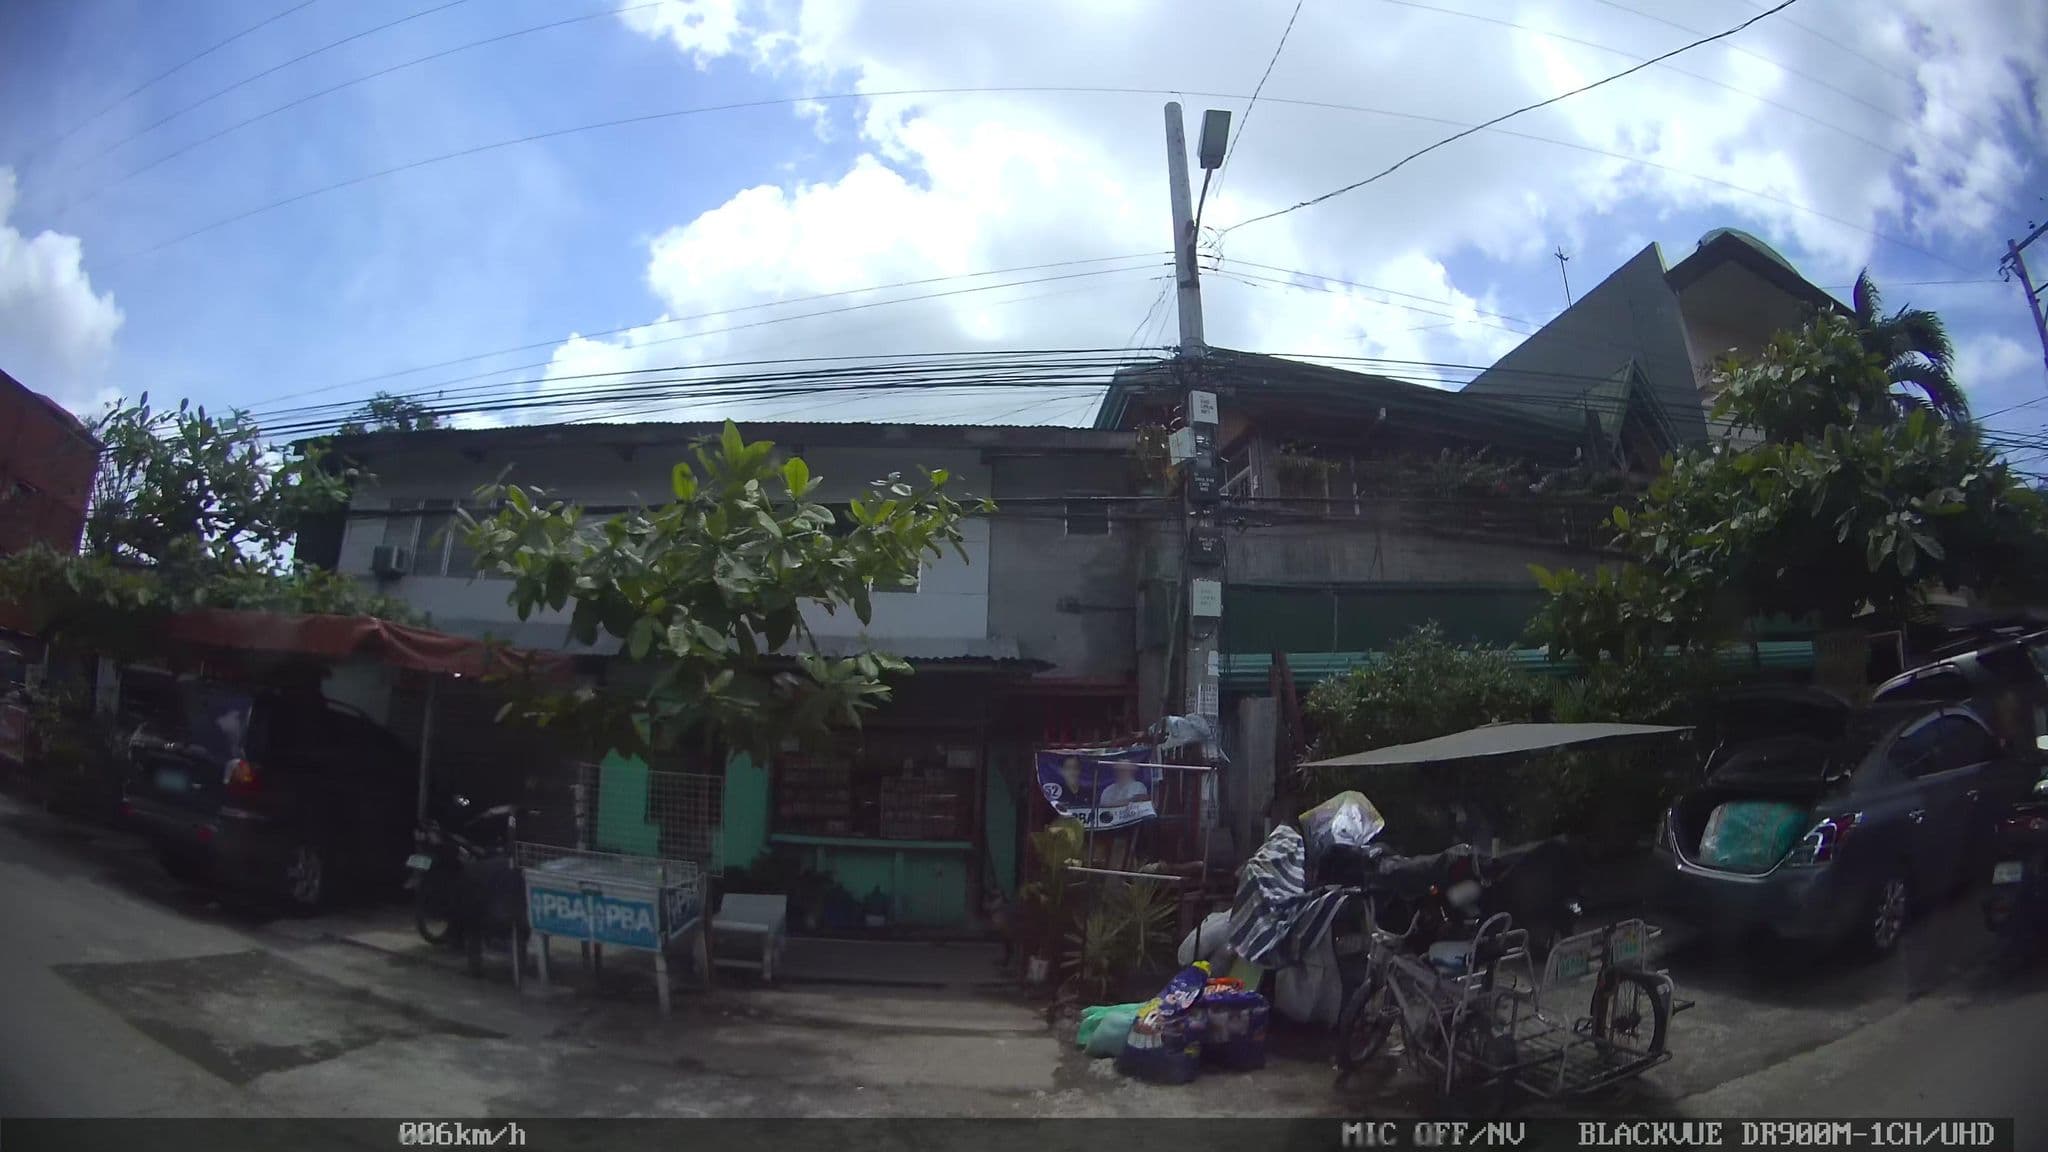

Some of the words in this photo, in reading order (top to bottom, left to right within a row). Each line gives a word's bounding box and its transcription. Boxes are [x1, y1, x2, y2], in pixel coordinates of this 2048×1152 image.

[1044, 784, 1059, 798] 52
[543, 893, 587, 922] PBA
[606, 904, 654, 933] PBA
